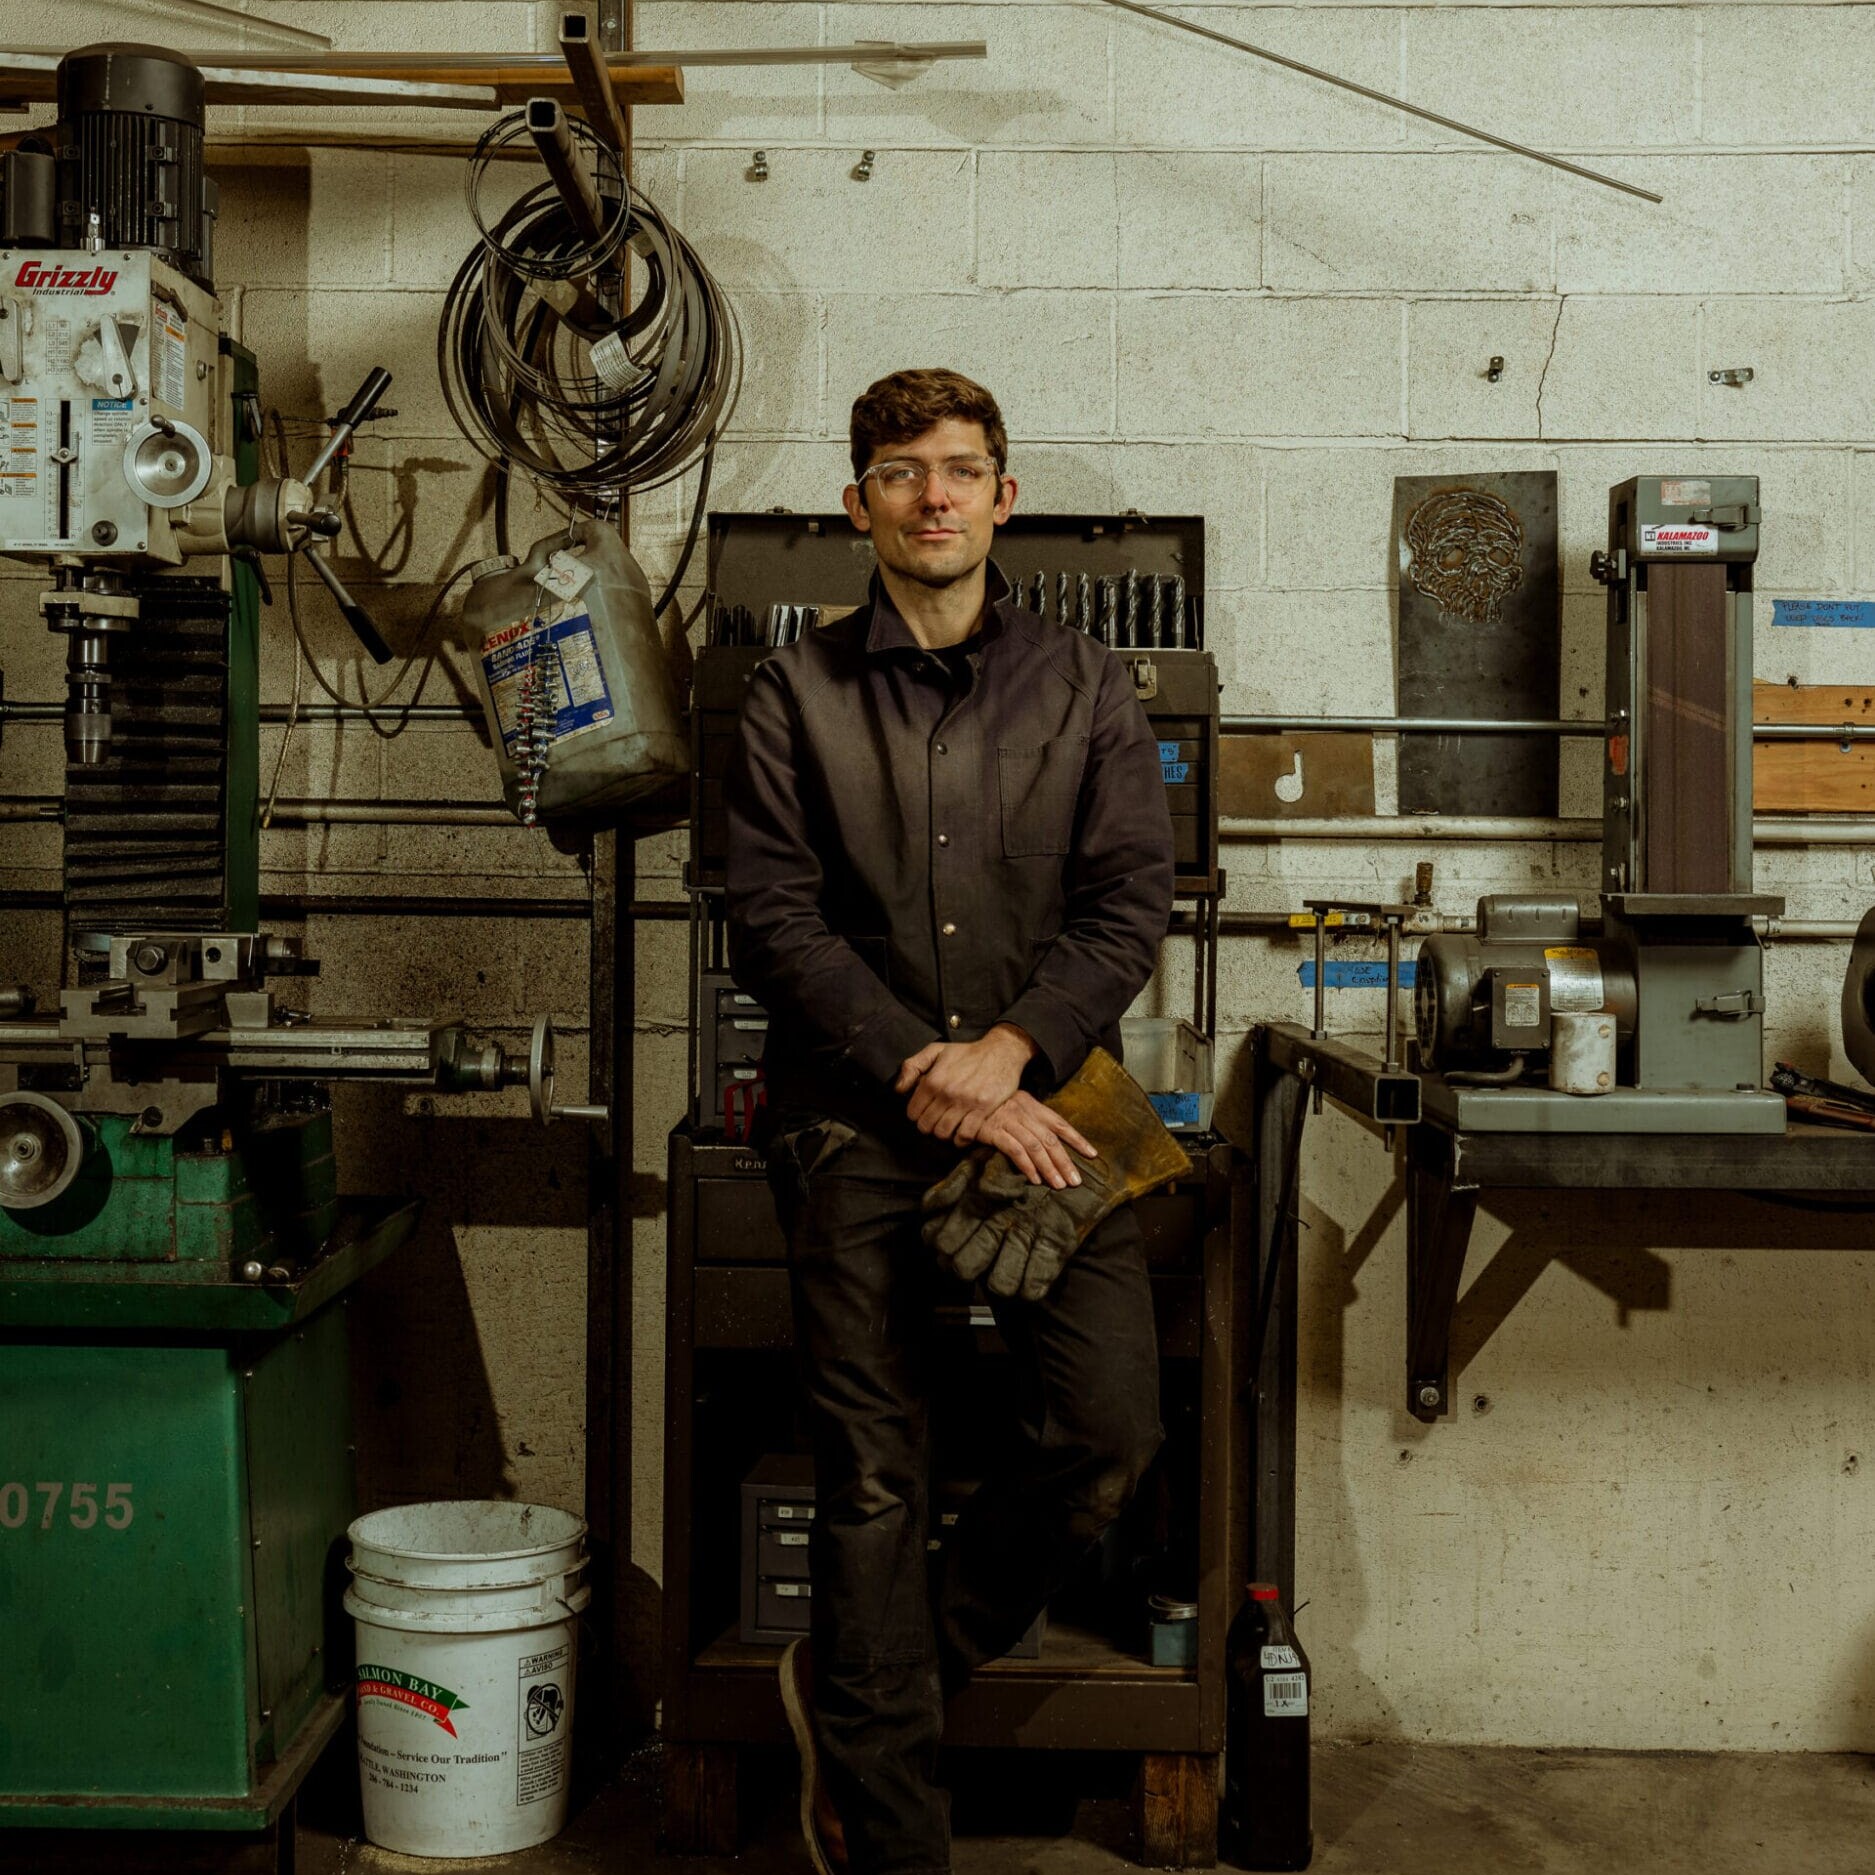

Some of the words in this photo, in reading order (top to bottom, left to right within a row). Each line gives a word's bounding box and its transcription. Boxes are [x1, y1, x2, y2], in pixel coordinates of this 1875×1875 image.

[15, 260, 119, 295] Grizzly
[32, 288, 84, 296] Industrial
[96, 401, 127, 409] NOTICE
[1656, 531, 1709, 540] KALAMAZOO
[482, 621, 530, 653] LENOX
[0, 1482, 134, 1529] 0755
[531, 1650, 563, 1665] WARNING
[531, 1662, 553, 1674] AVISO
[408, 1678, 443, 1700] BAY
[380, 1686, 418, 1704] GRAVEL
[420, 1700, 440, 1716] CO.
[396, 1749, 429, 1764] Service
[430, 1753, 451, 1765] Our
[382, 1765, 446, 1783] WASHINGTON
[400, 1783, 419, 1794] 1234
